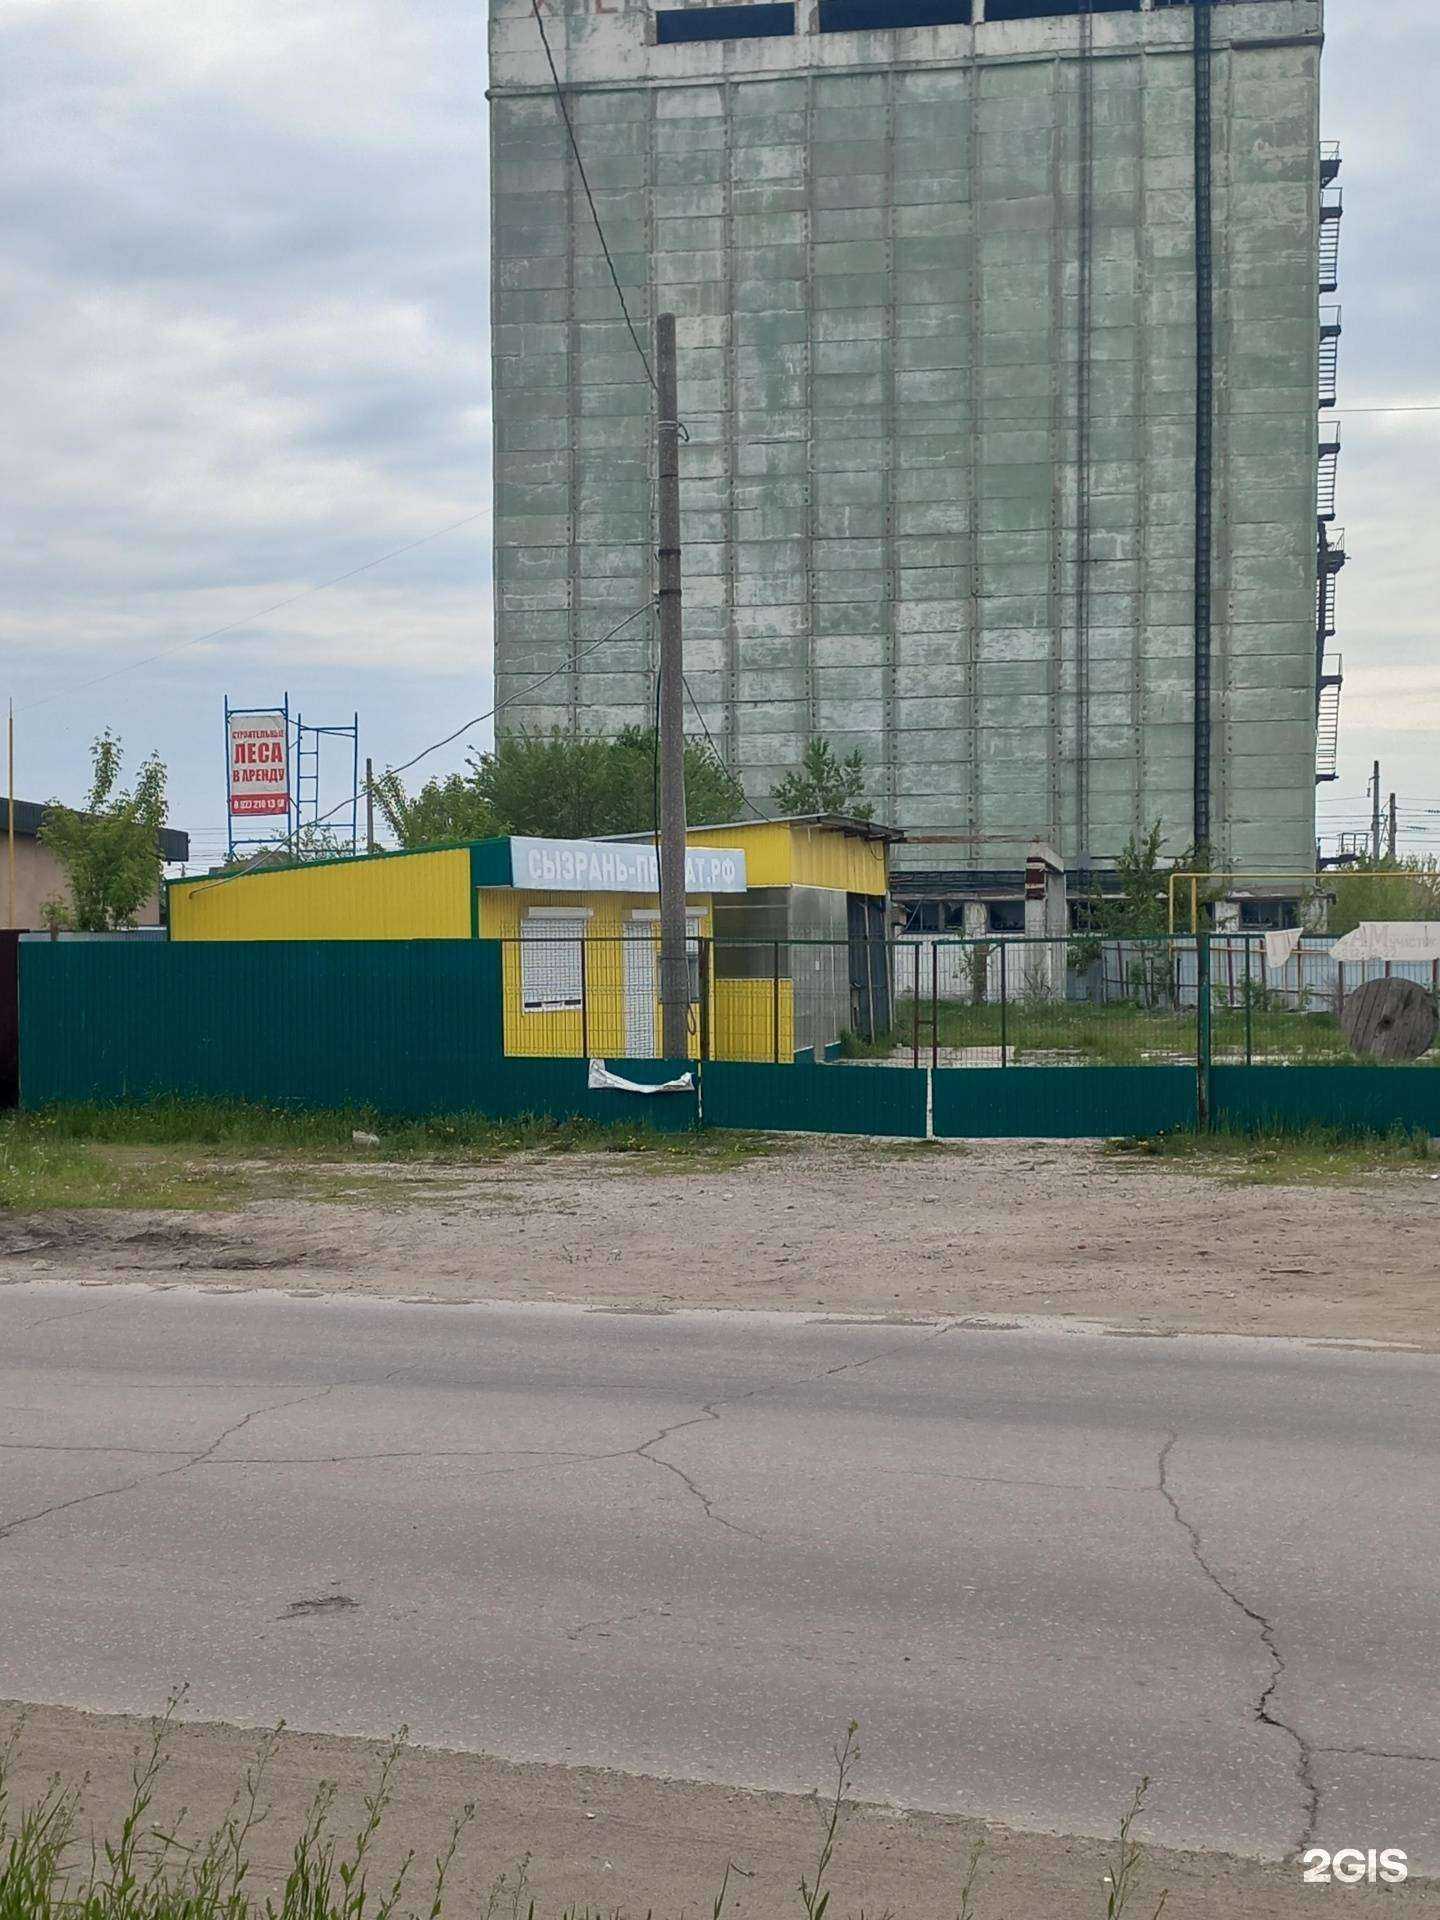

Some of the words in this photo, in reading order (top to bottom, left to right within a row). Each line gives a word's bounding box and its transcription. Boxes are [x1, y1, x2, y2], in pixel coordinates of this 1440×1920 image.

[234, 742, 283, 764] ЛЕСА
[233, 769, 240, 782] В
[242, 768, 285, 783] АРЕНДУ
[528, 848, 736, 884] СЫЗРАНЬ-ПРАТ.РФ
